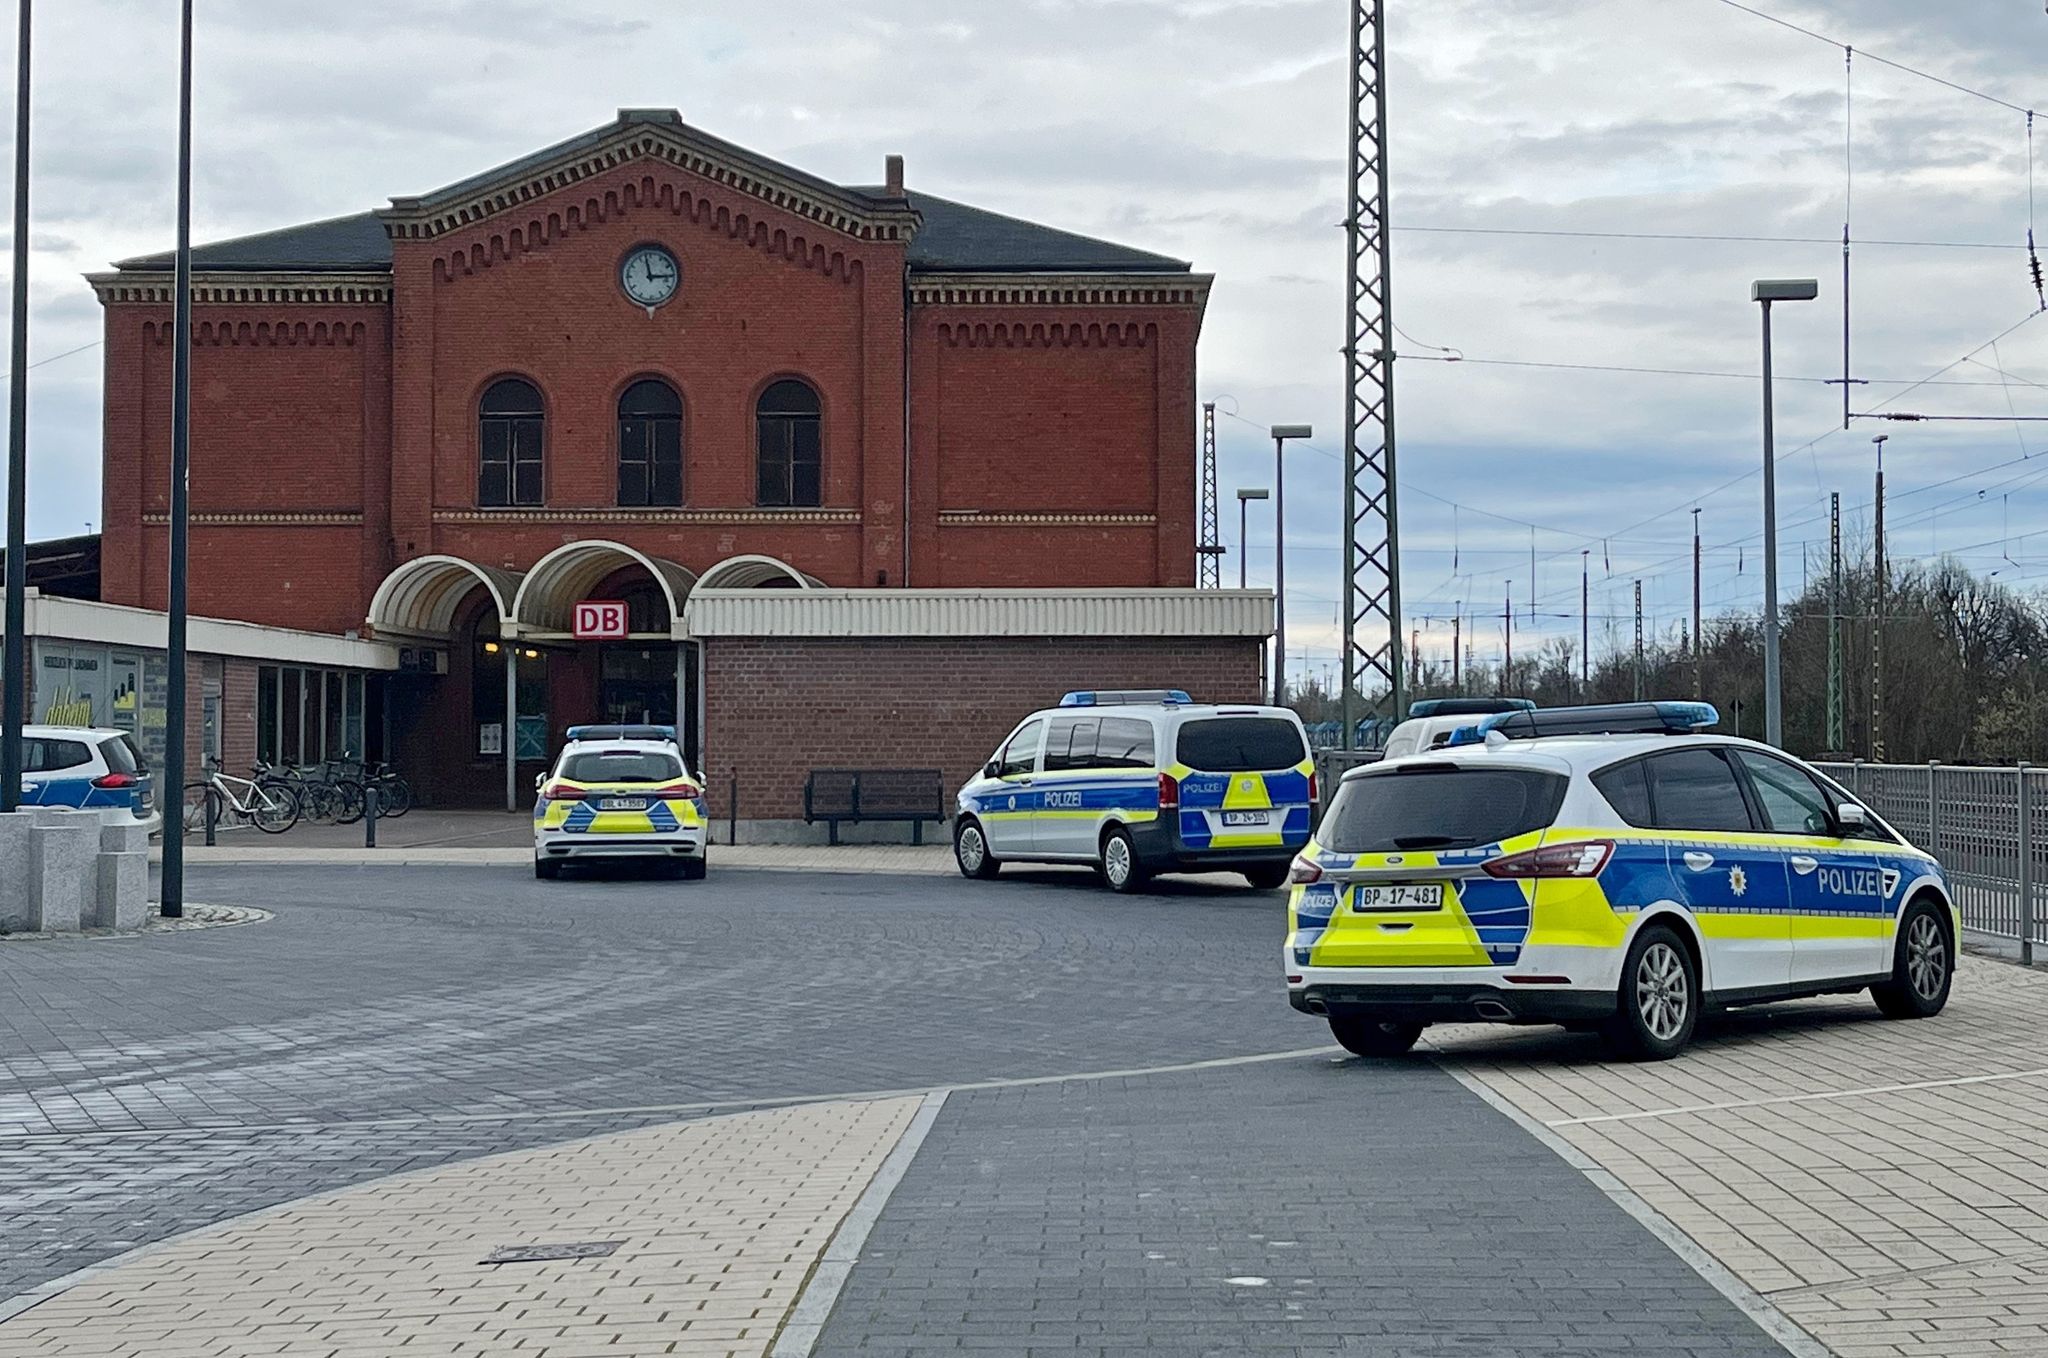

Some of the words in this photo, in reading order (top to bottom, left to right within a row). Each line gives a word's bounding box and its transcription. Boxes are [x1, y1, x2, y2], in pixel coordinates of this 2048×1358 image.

[580, 608, 620, 632] DB
[1183, 782, 1223, 794] POLIZEI
[1044, 791, 1082, 808] POLIZEI
[1817, 868, 1881, 896] POLIZEI
[1364, 888, 1381, 906] BP
[1389, 887, 1438, 905] 17-481
